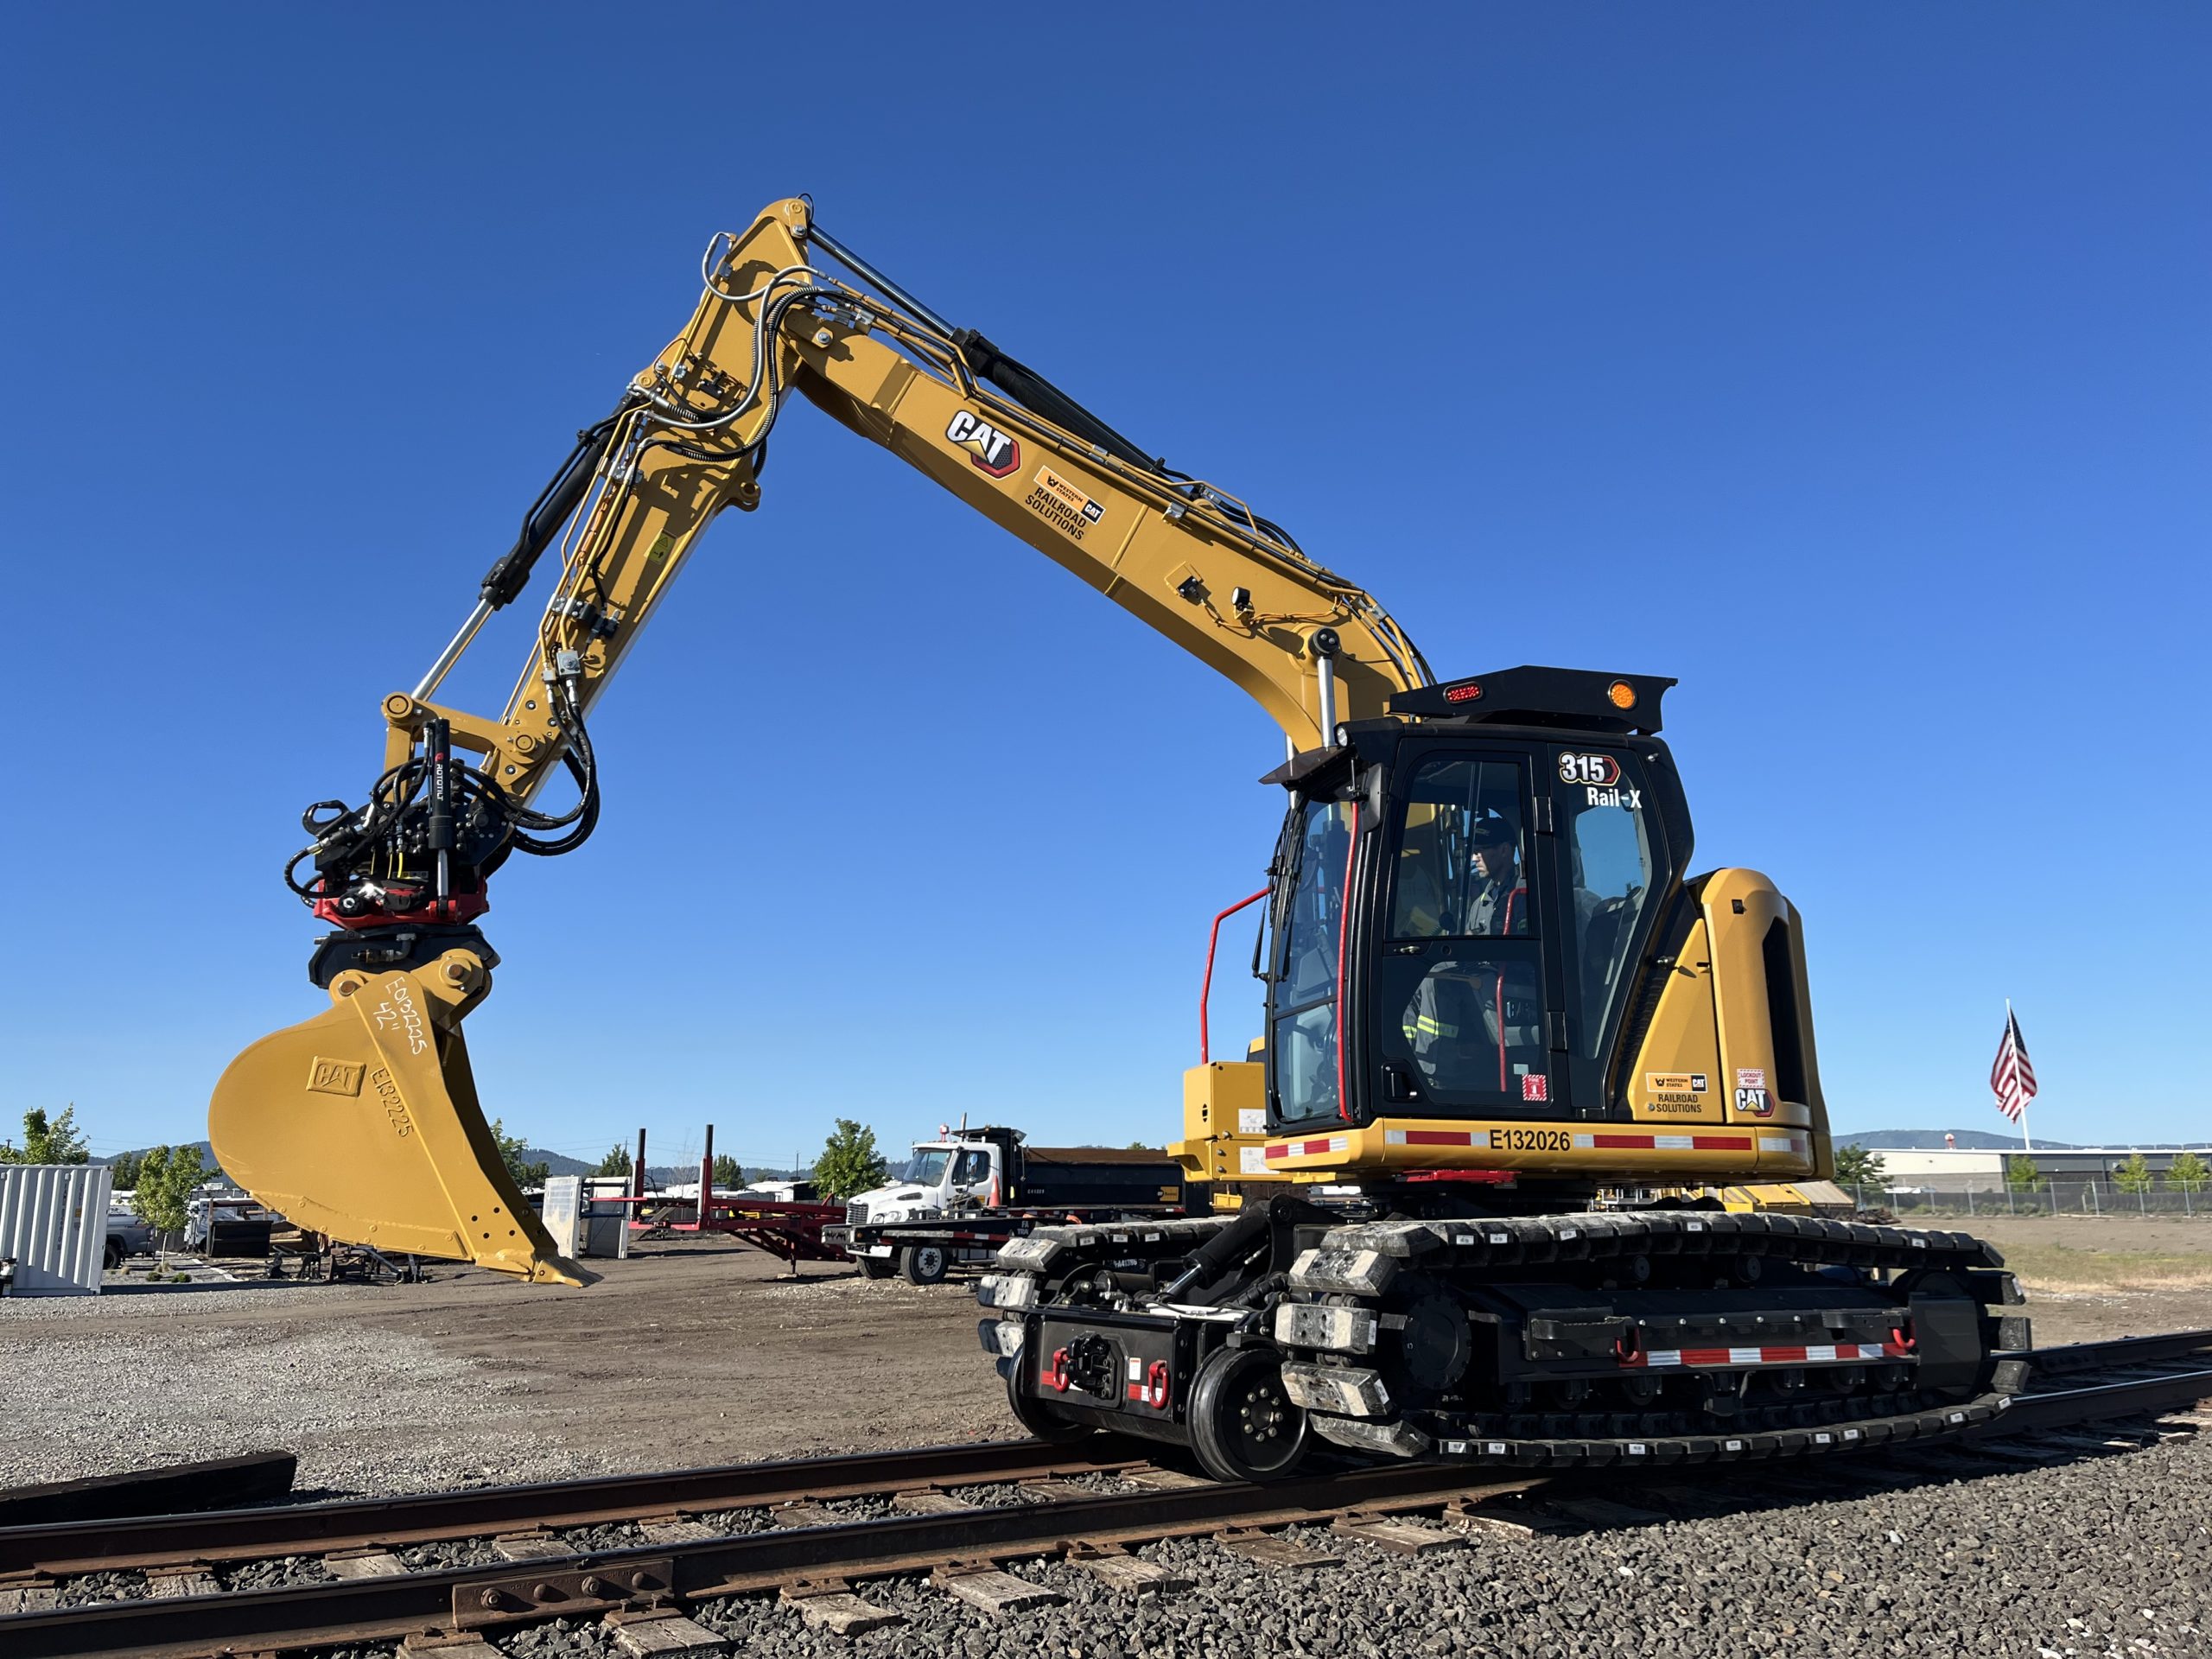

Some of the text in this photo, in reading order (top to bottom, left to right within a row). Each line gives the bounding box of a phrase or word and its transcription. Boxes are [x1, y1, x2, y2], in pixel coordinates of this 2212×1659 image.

[946, 410, 1012, 464] CAT
[1056, 487, 1074, 502] STATES
[1058, 483, 1084, 503] WESTERN
[1025, 495, 1084, 540] SOLUTIONS
[1034, 487, 1087, 528] RAILROAD
[1084, 504, 1102, 518] CAT
[1561, 754, 1605, 782] 315
[1586, 787, 1642, 808] Rail-X
[315, 1064, 359, 1091] CAT
[1656, 1103, 1702, 1113] SOLUTIONS
[1658, 1094, 1698, 1103] RAILROAD
[1735, 1089, 1766, 1111] CAT
[1489, 1129, 1571, 1151] E132026
